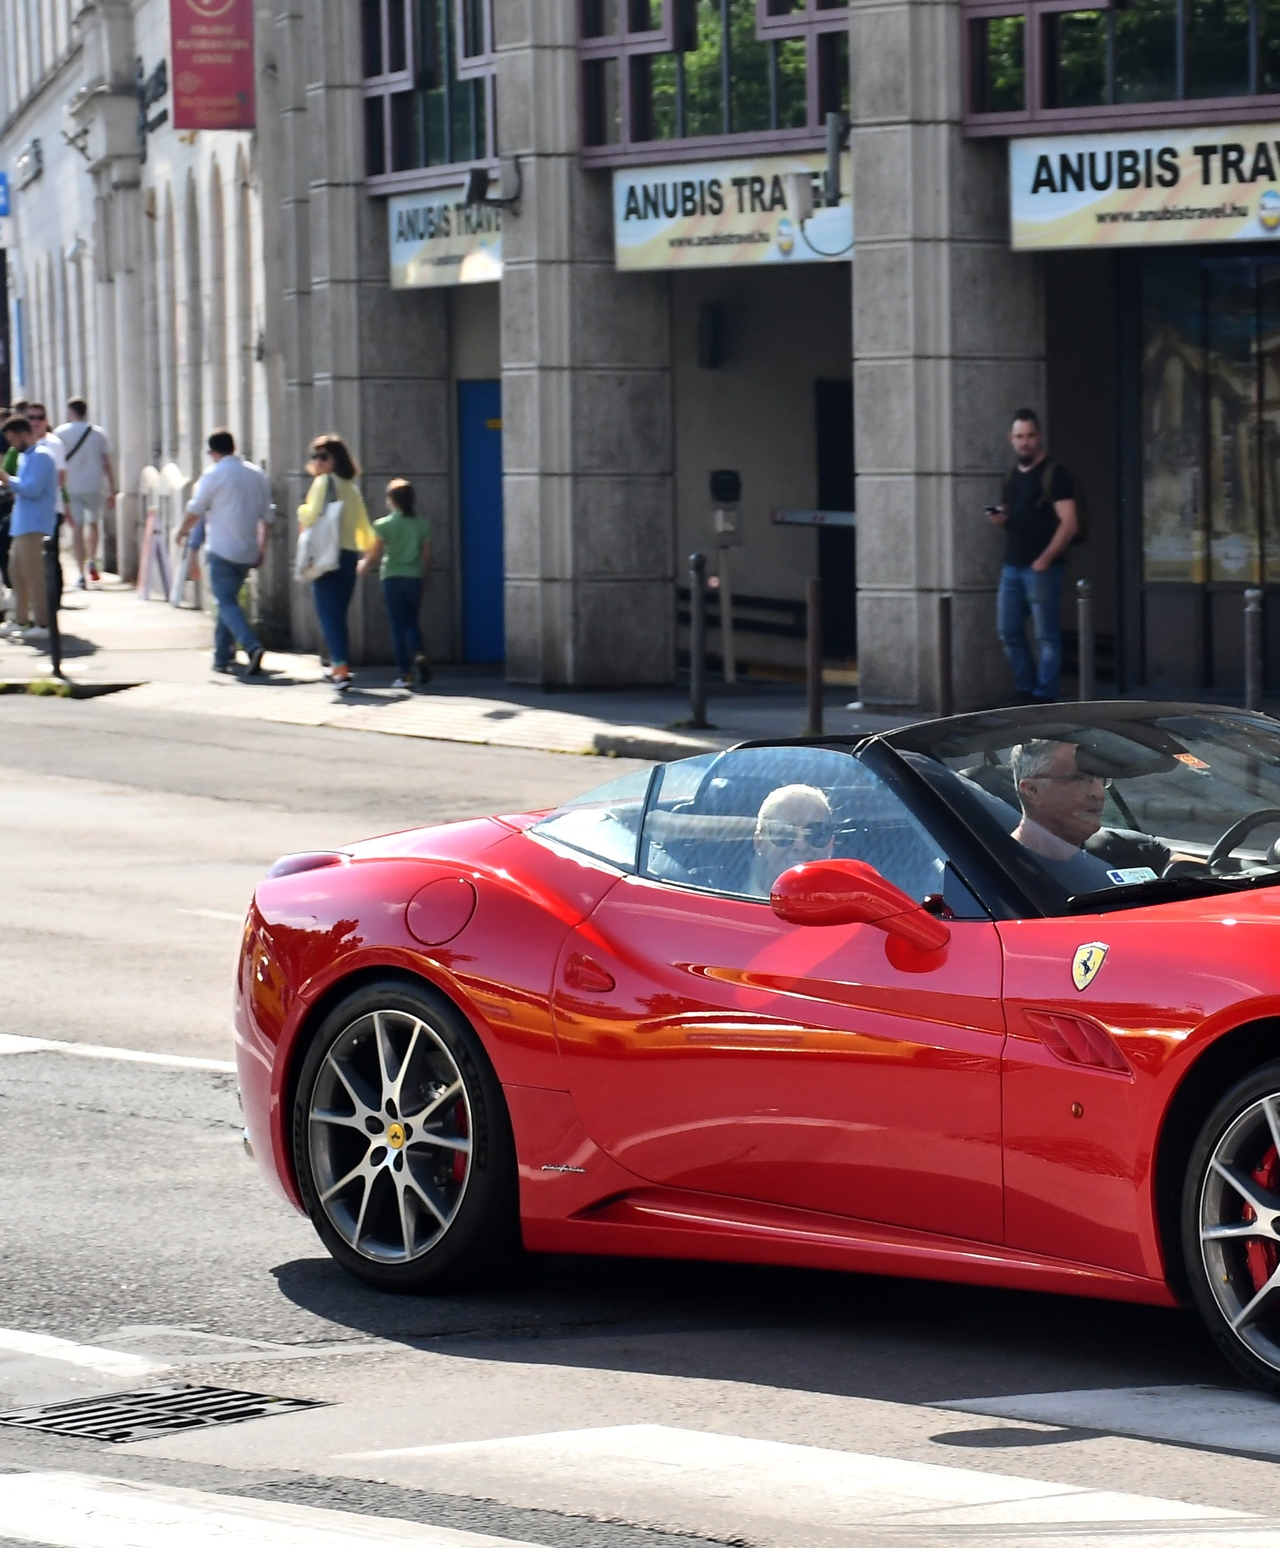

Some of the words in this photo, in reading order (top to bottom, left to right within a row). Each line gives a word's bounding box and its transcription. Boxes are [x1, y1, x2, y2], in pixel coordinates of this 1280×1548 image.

[1031, 147, 1180, 194] ANUBIS
[625, 179, 724, 221] ANUBIS
[730, 170, 839, 214] TRAEL
[1096, 202, 1248, 223] www.anubistravel.hu
[396, 204, 451, 242] ANUBIS
